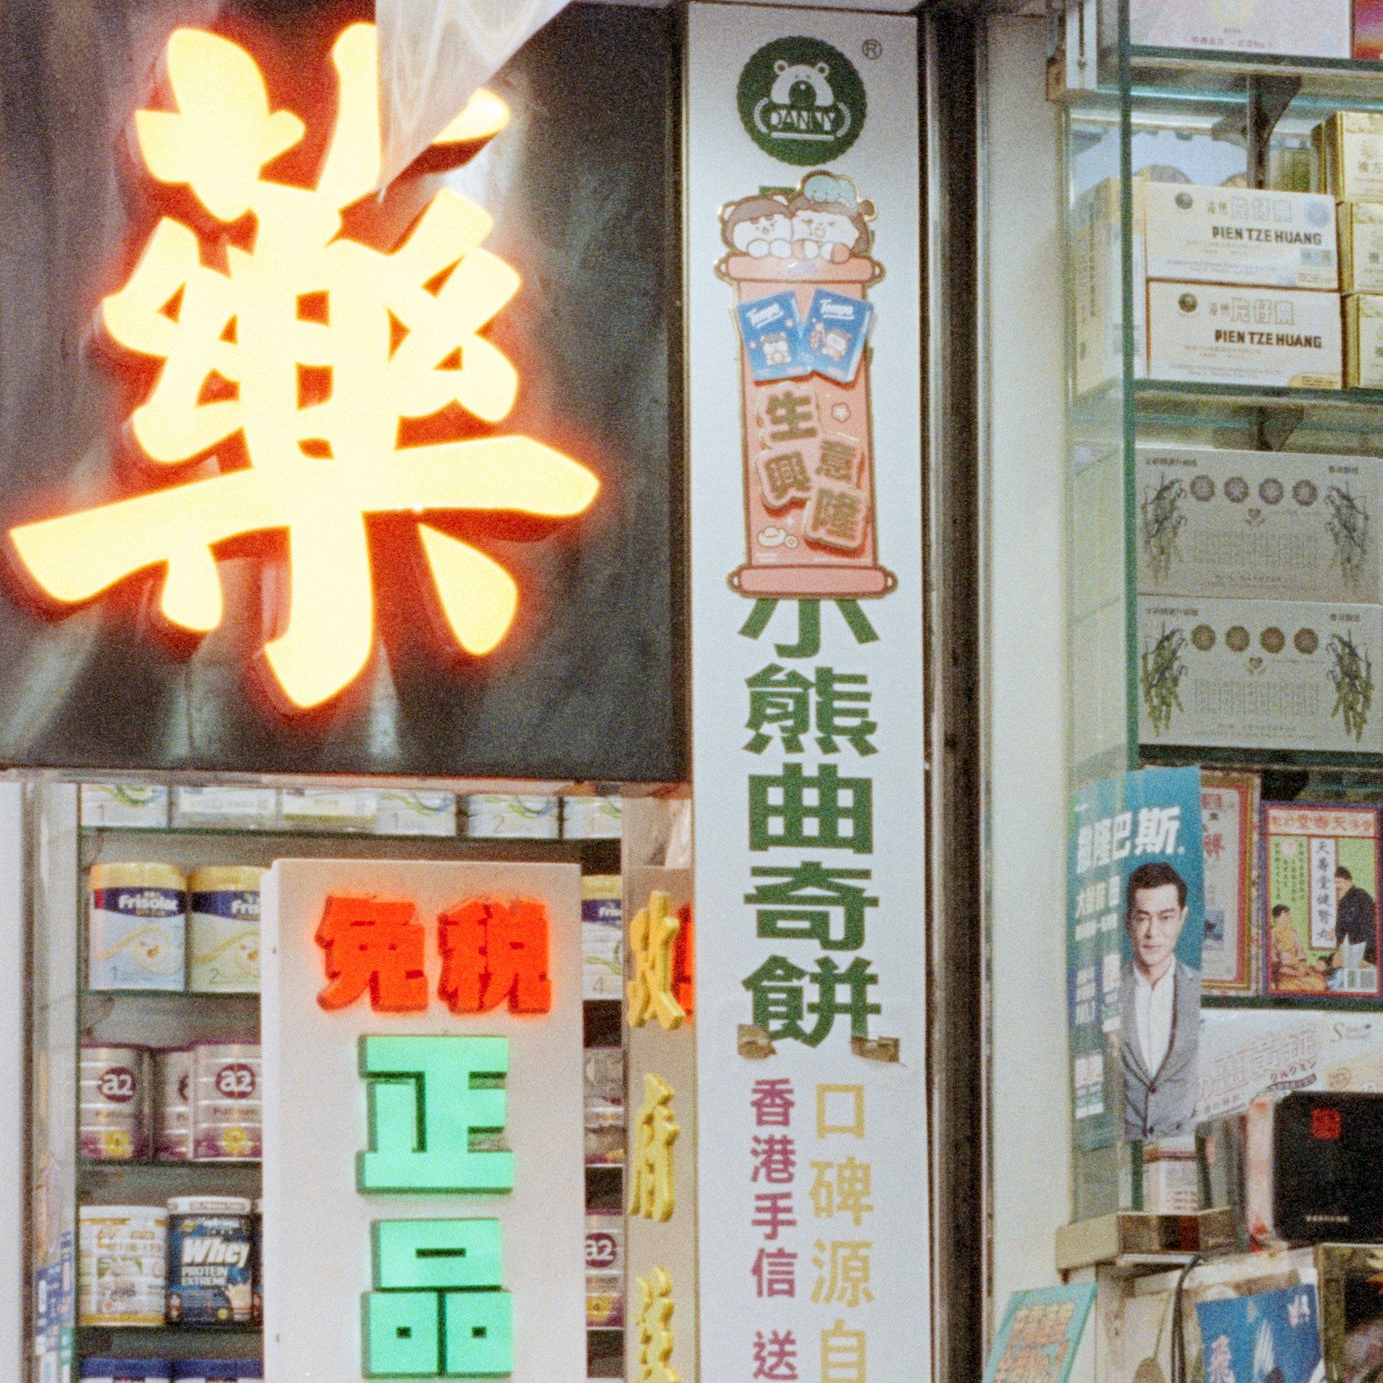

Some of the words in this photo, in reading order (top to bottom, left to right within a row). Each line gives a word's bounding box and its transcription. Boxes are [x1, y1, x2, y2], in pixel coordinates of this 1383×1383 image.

[769, 104, 838, 132] DANNY
[1212, 226, 1243, 240] PIEN
[1246, 227, 1271, 242] TZE
[1274, 230, 1322, 246] HUANG
[1214, 329, 1245, 343] PIEN
[1247, 331, 1273, 344] TZE
[1275, 333, 1323, 349] HUANG
[100, 1071, 136, 1096] a2
[219, 1070, 254, 1095] a2
[749, 1077, 798, 1298] 香港手信
